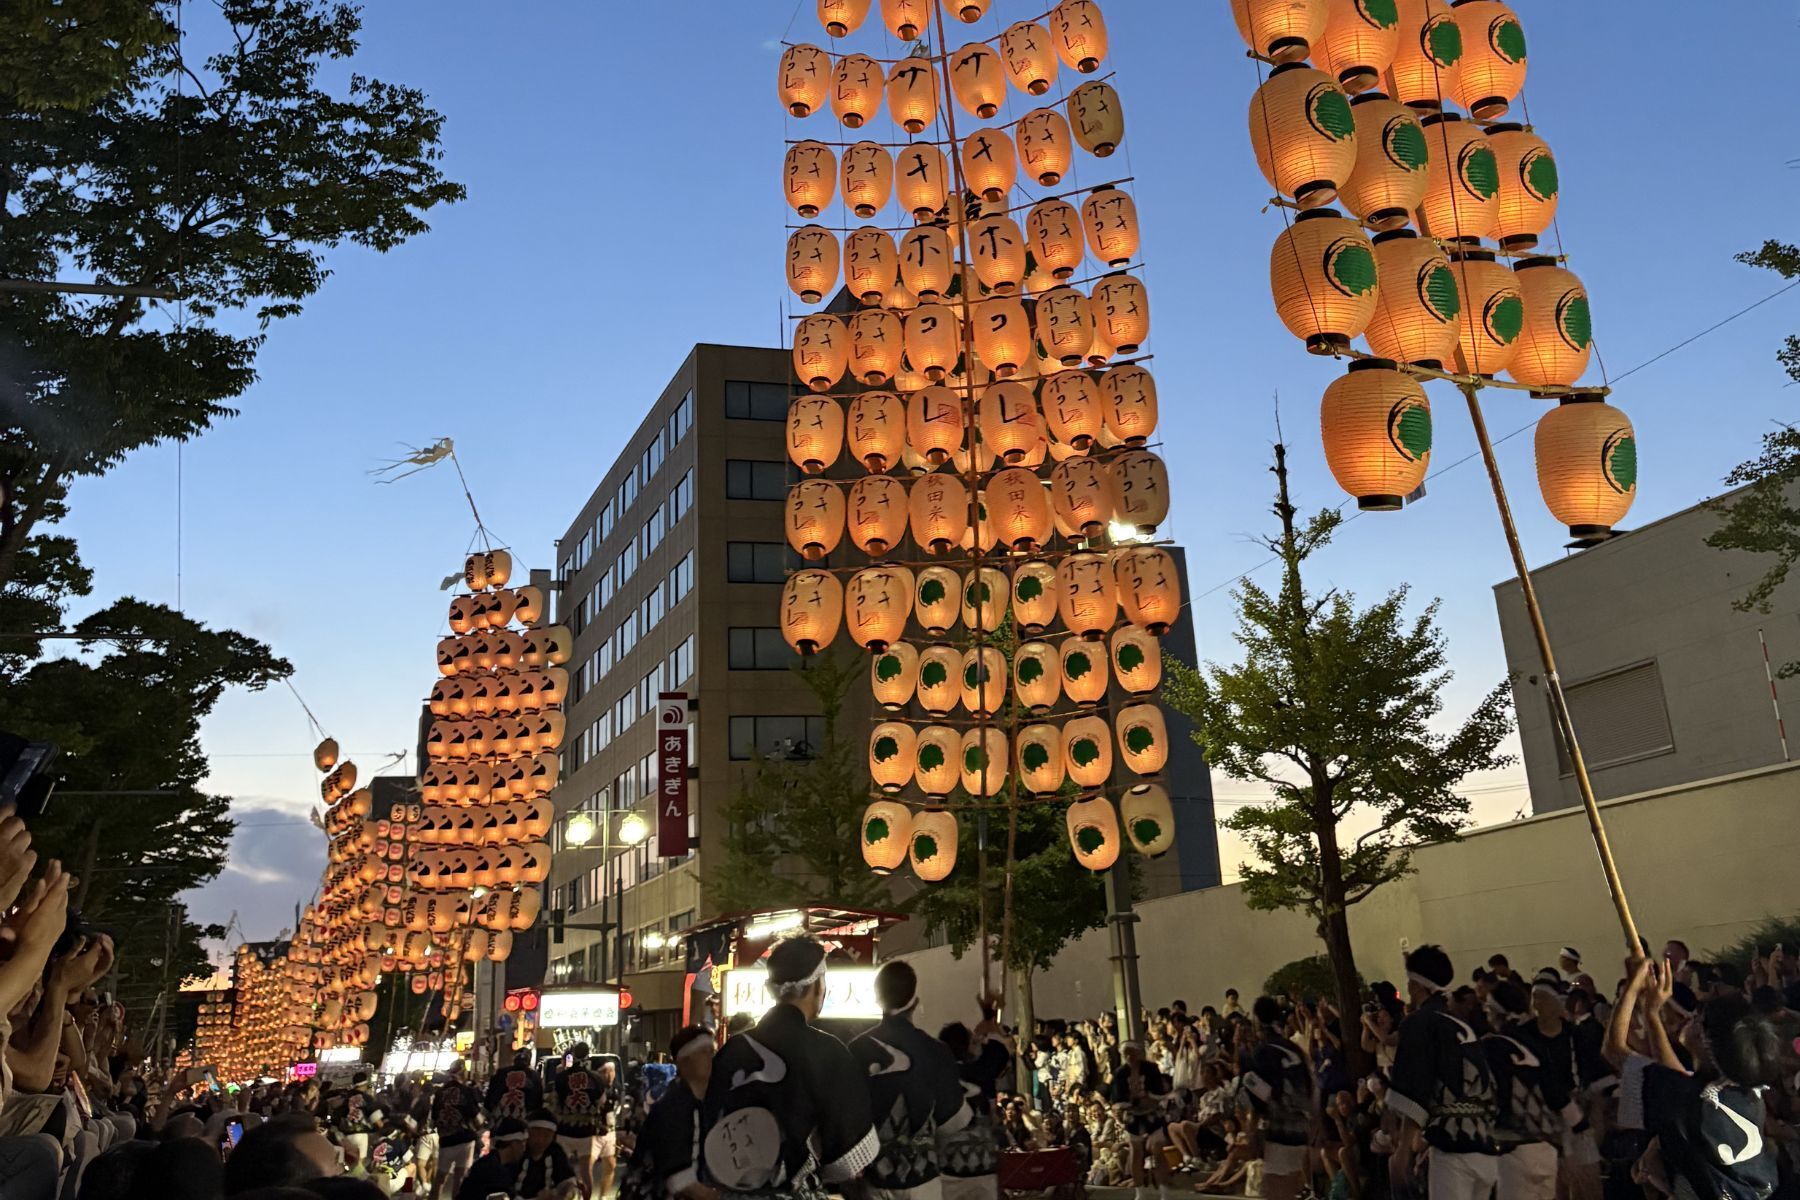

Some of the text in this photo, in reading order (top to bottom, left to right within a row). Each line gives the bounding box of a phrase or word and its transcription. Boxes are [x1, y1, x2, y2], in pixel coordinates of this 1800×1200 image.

[926, 475, 948, 522] 秋田米
[1003, 472, 1029, 521] 秋田米
[665, 736, 682, 817] あきぎん
